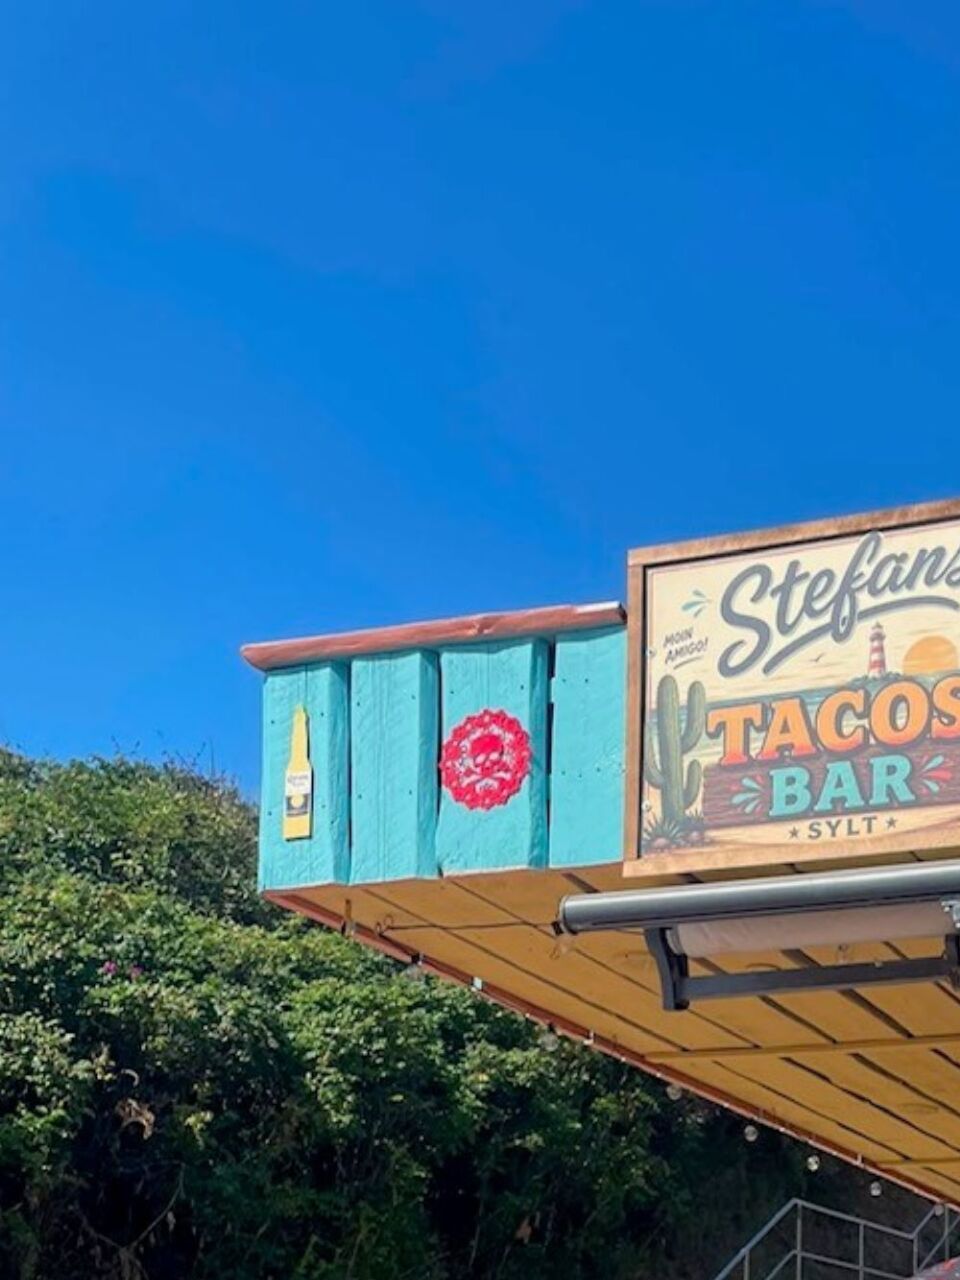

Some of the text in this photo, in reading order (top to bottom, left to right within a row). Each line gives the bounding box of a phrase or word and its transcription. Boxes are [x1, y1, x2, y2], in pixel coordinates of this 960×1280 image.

[663, 626, 694, 648] MOIN
[768, 754, 916, 817] BAR
[807, 816, 878, 841] SYLT
